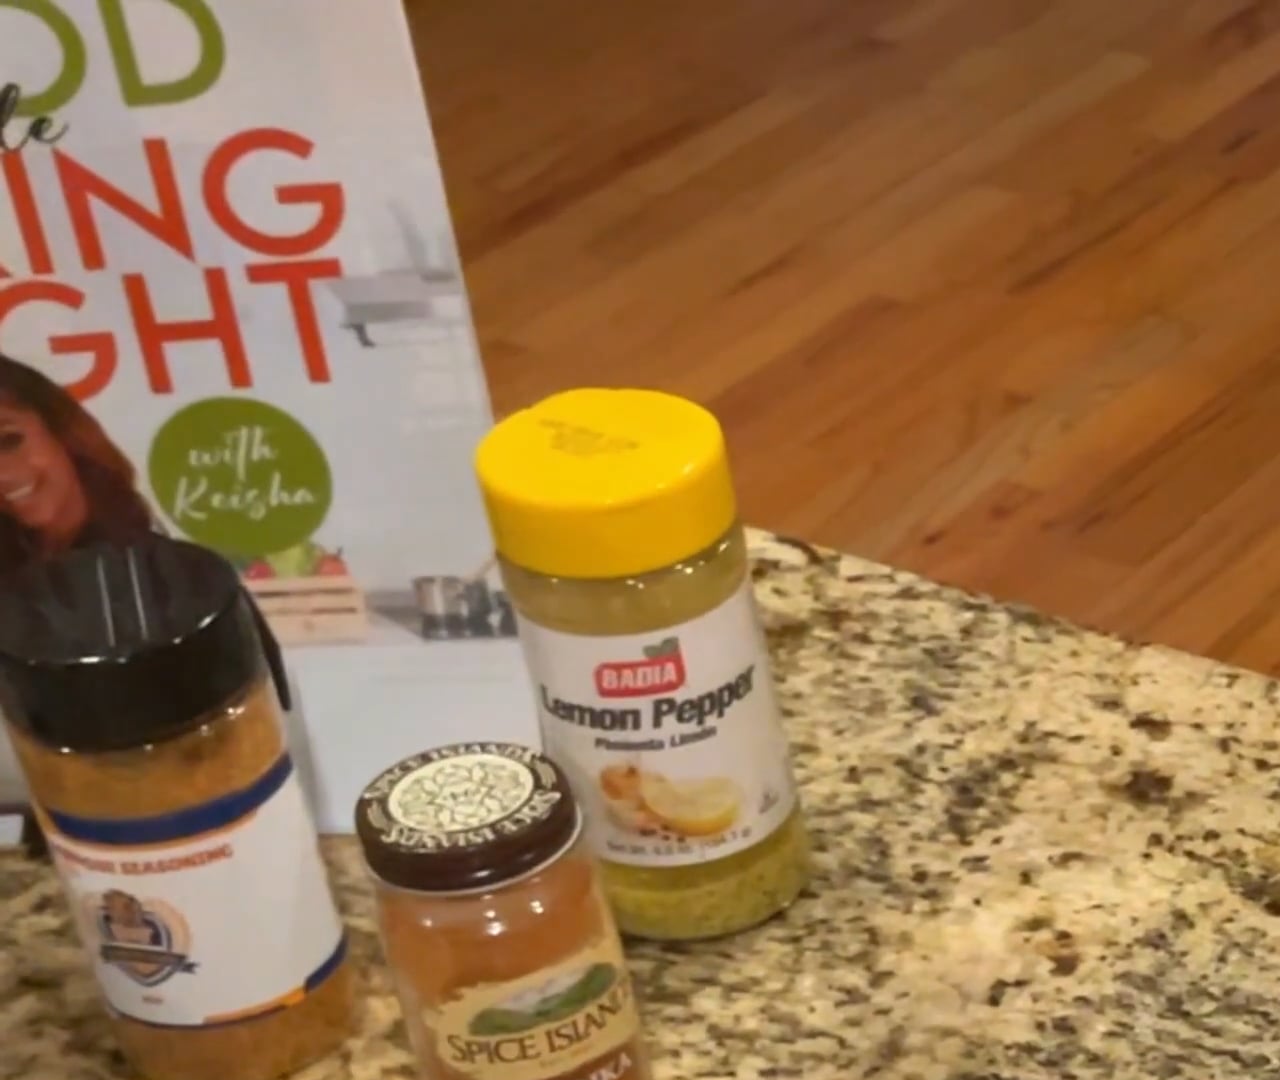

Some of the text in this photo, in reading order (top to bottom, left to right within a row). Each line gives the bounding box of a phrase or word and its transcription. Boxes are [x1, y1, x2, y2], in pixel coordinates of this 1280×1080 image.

[0, 127, 345, 277] ING
[189, 424, 277, 482] with
[540, 664, 756, 732] Lemon Pepper
[602, 661, 678, 690] BADIA
[447, 1034, 541, 1065] SPICE
